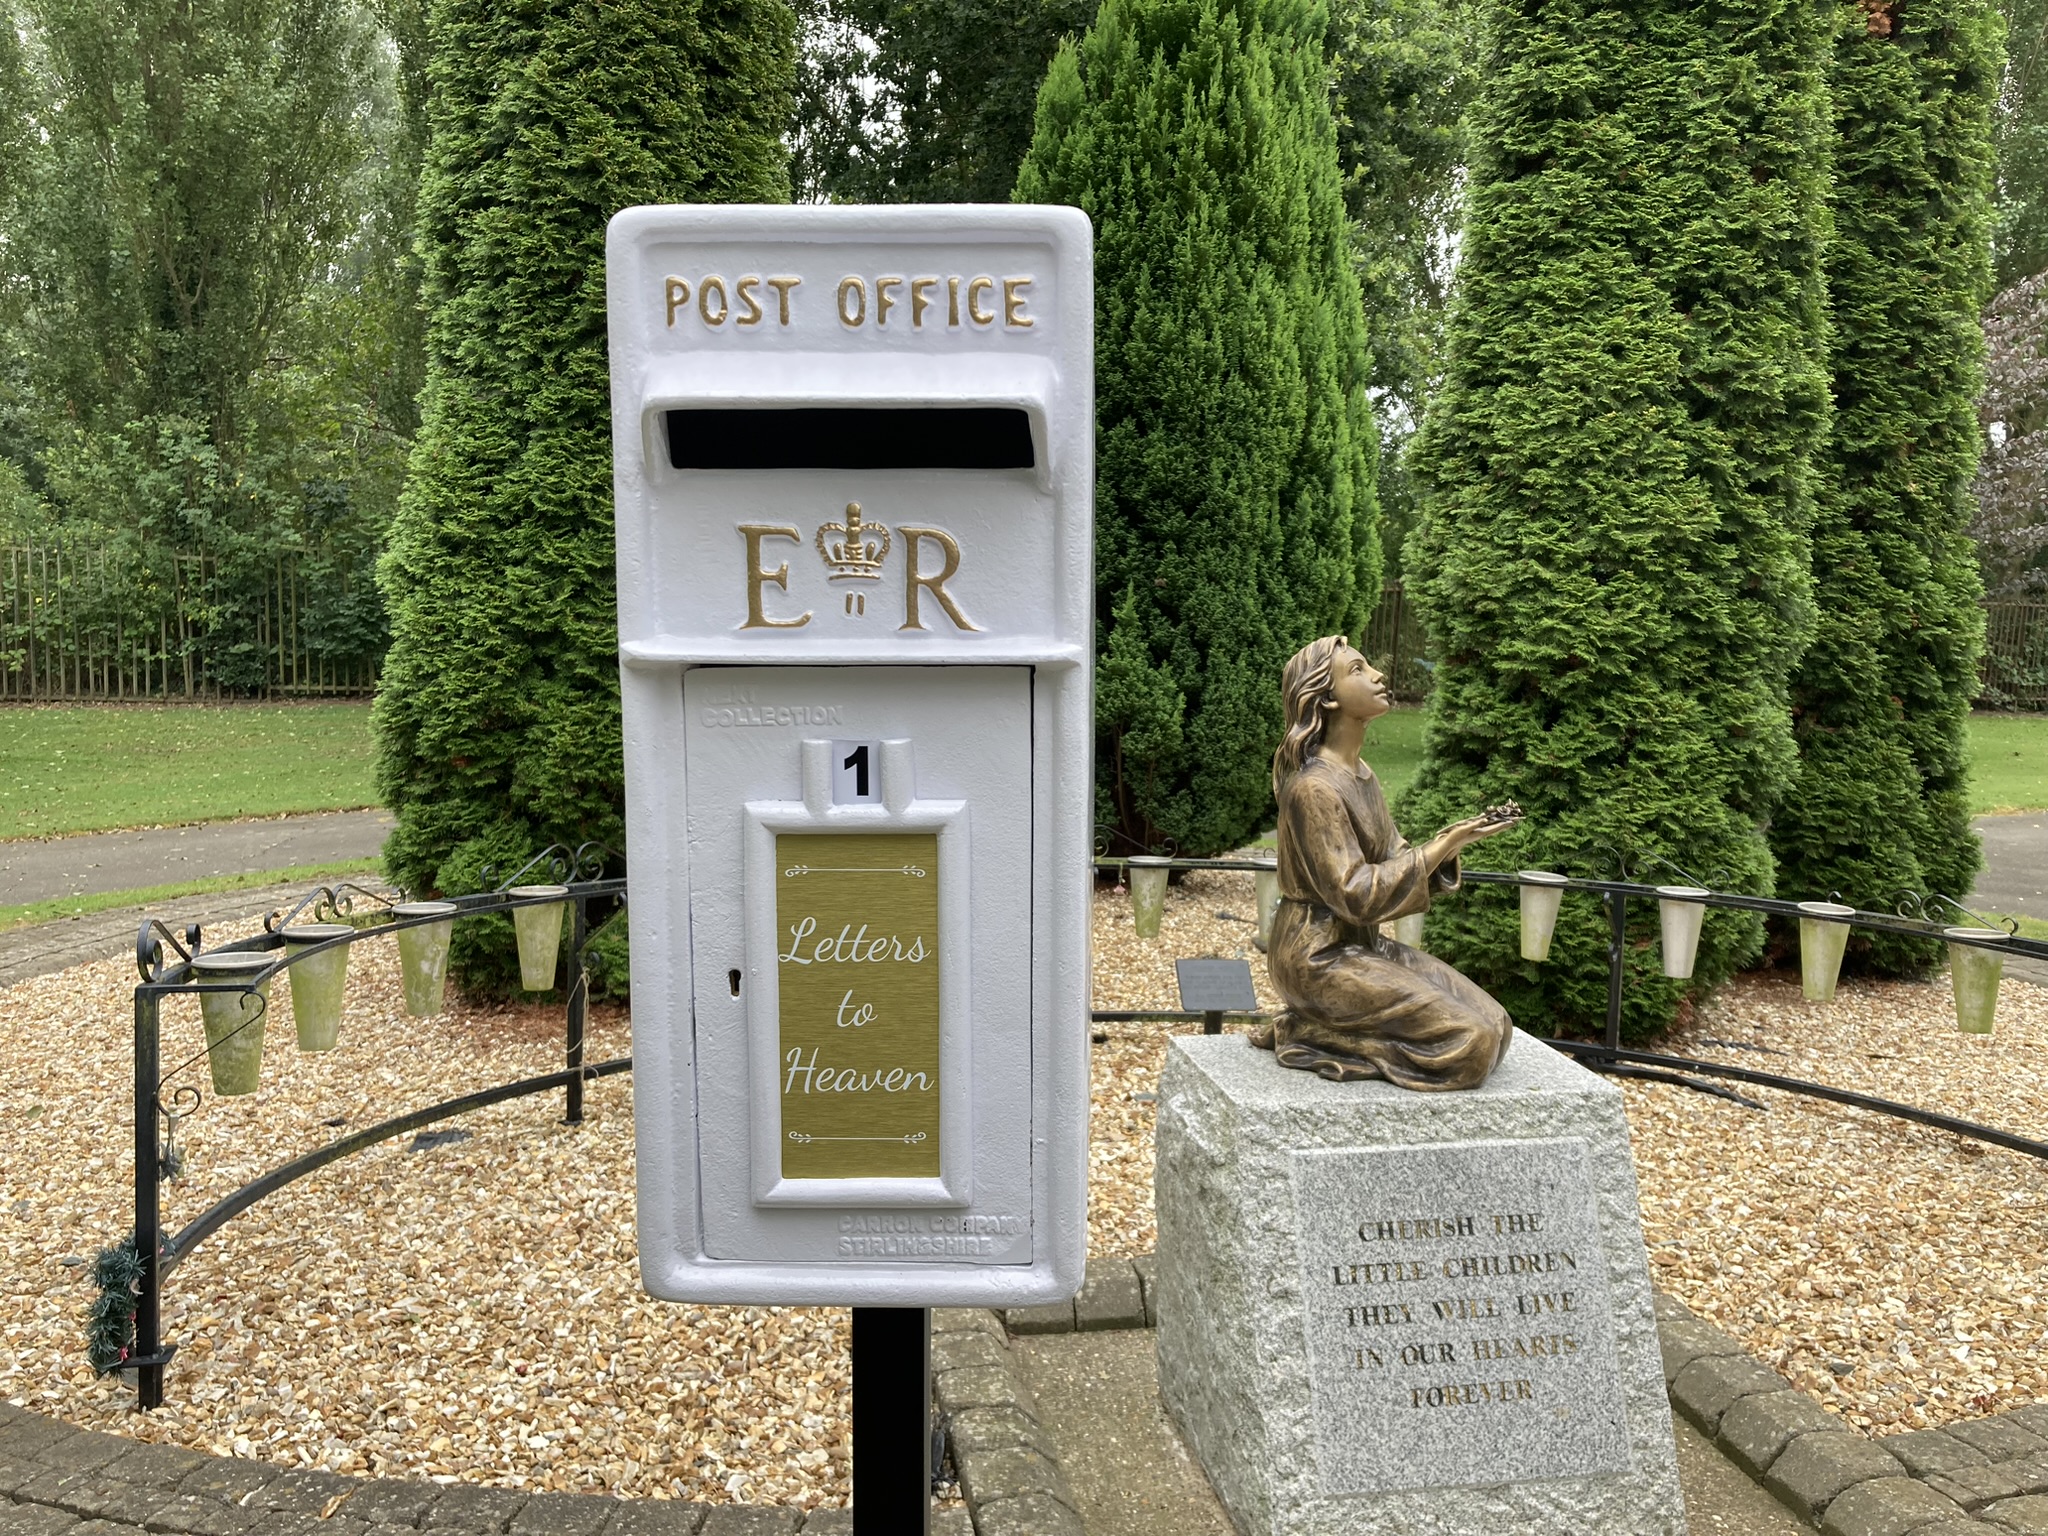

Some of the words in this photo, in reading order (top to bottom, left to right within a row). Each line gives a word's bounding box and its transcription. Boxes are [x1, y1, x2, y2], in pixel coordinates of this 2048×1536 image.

[664, 276, 801, 327] POST
[838, 276, 1034, 327] OFFICE
[738, 524, 813, 630] E
[897, 525, 980, 631] R
[701, 705, 843, 728] COLLECTION
[843, 745, 869, 796] 1
[778, 916, 932, 965] Letters
[836, 989, 878, 1028] to
[785, 1046, 935, 1095] Heaven
[1358, 1217, 1475, 1243] CHERISH
[1491, 1213, 1544, 1236] THE
[837, 1236, 991, 1257] STIRLINGSHIRE
[1333, 1261, 1427, 1286] LITTLE
[1443, 1252, 1578, 1279] CHILDREN
[1344, 1304, 1413, 1327] THEY
[1432, 1298, 1501, 1321] WILL
[1517, 1292, 1577, 1316] LIVE
[1355, 1349, 1384, 1370] IN
[1401, 1343, 1456, 1366] OUR
[1472, 1334, 1577, 1361] HEARTS
[1411, 1380, 1533, 1408] FOREVER
